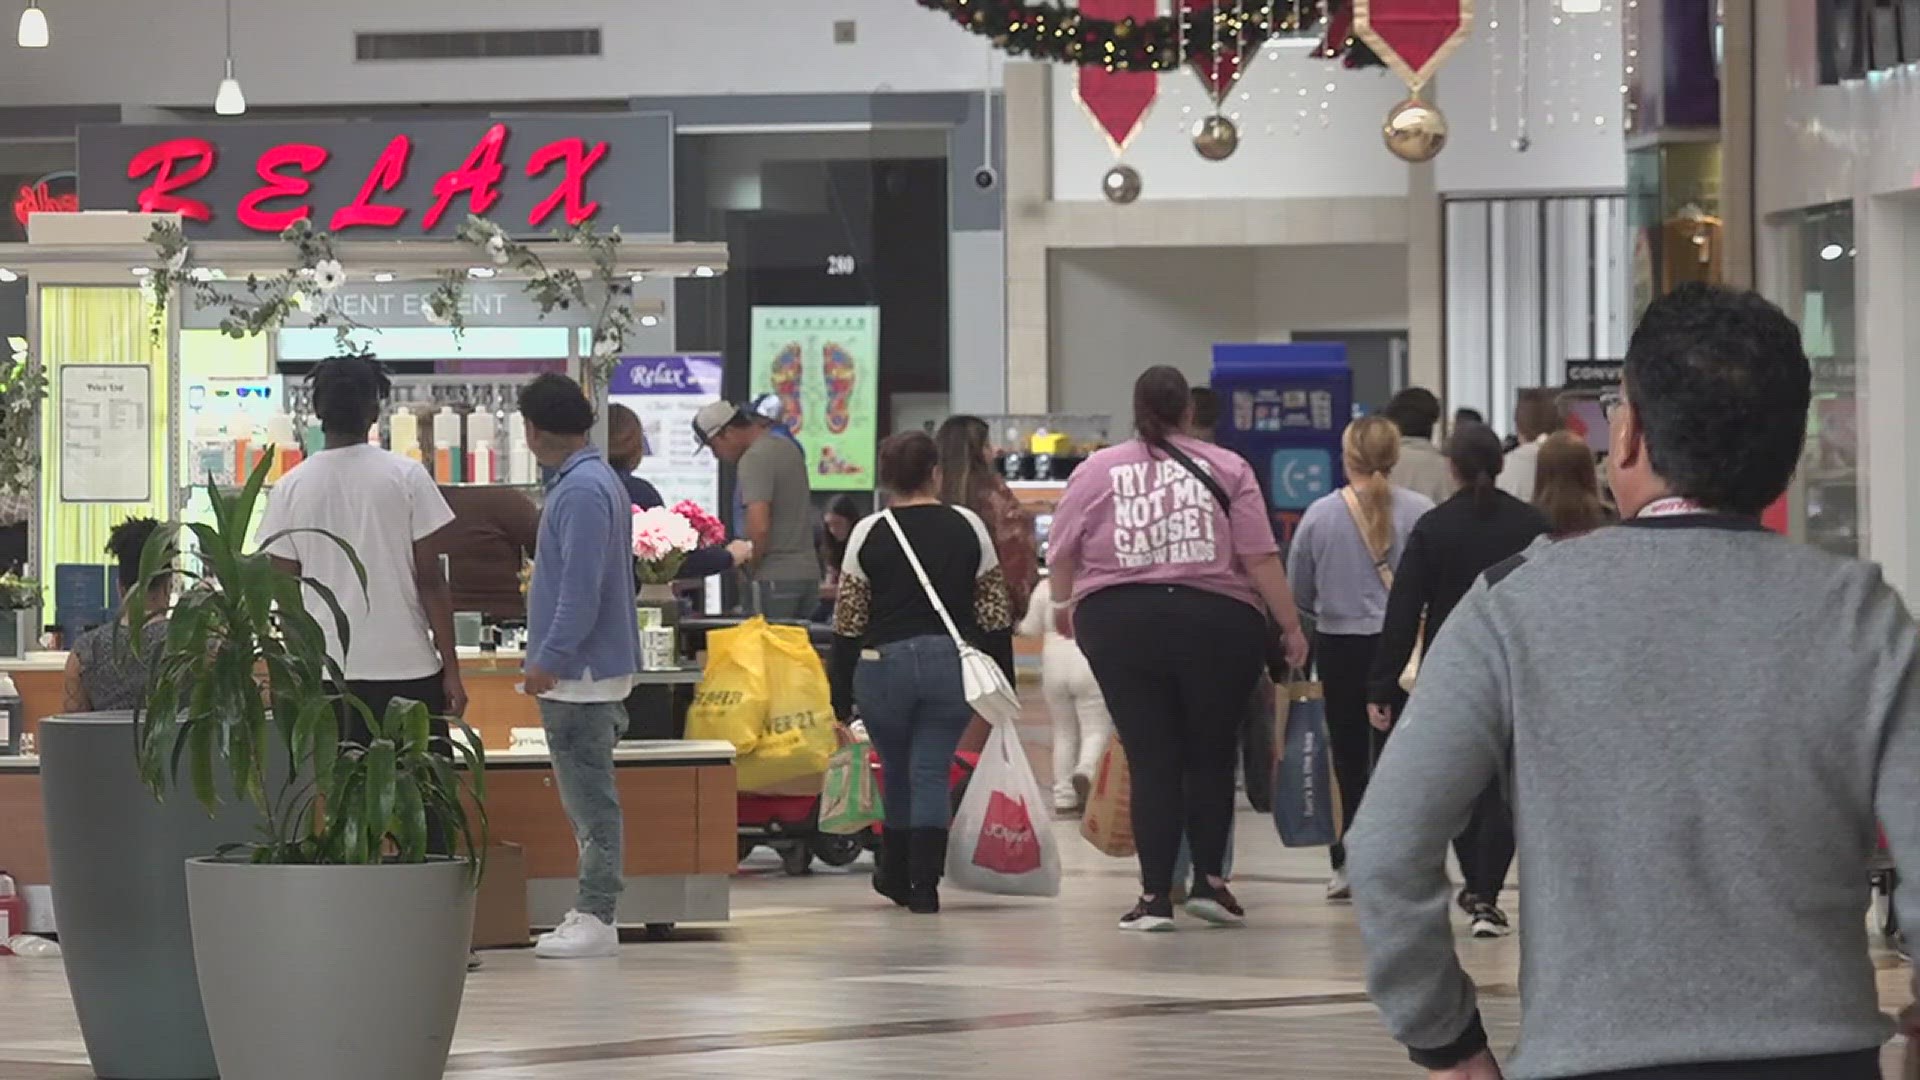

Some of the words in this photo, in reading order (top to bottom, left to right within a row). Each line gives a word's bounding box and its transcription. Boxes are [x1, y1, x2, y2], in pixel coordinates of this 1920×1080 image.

[128, 123, 608, 231] RELAX
[826, 254, 855, 275] 280
[630, 362, 686, 388] Relax
[1109, 462, 1149, 497] TRY
[1113, 487, 1166, 529] NOT
[1172, 478, 1213, 512] ME
[1114, 508, 1200, 555] CAUSE
[1204, 511, 1214, 542] I
[1115, 546, 1168, 568] THROW
[1169, 541, 1215, 564] HANDS
